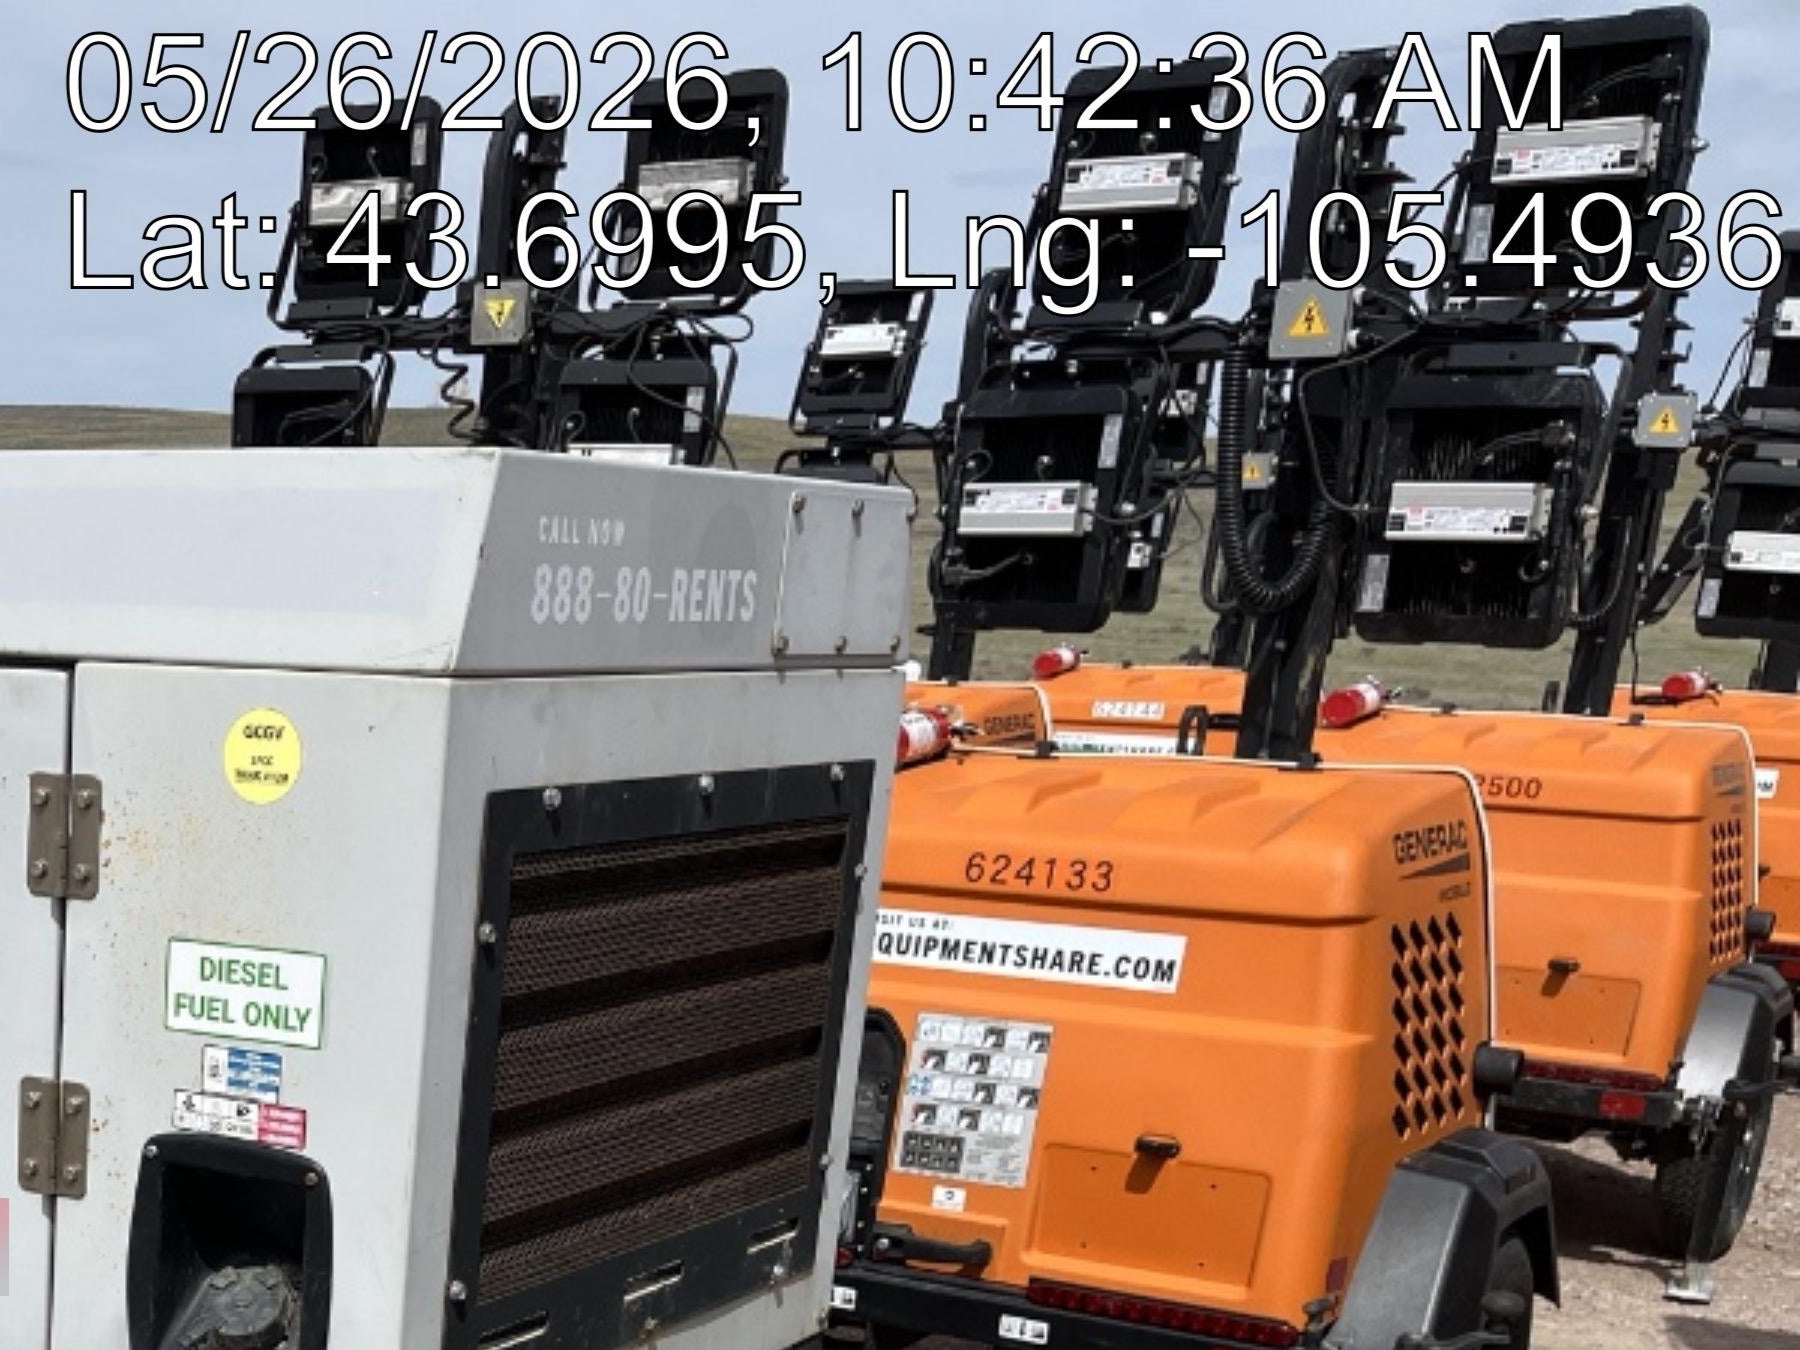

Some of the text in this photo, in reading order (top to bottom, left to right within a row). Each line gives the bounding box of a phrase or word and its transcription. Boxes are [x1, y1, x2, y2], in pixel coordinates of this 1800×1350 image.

[538, 515, 625, 546] CALL NOW
[530, 563, 757, 624] 888-80-RENTS
[1392, 818, 1468, 865] GENERAC
[965, 851, 1115, 893] 624133
[874, 913, 904, 925] ISIT
[200, 956, 289, 991] DIESEL
[877, 931, 1177, 983] QUIPMENTSHARE.COM
[174, 992, 313, 1033] FUEL ONLY
